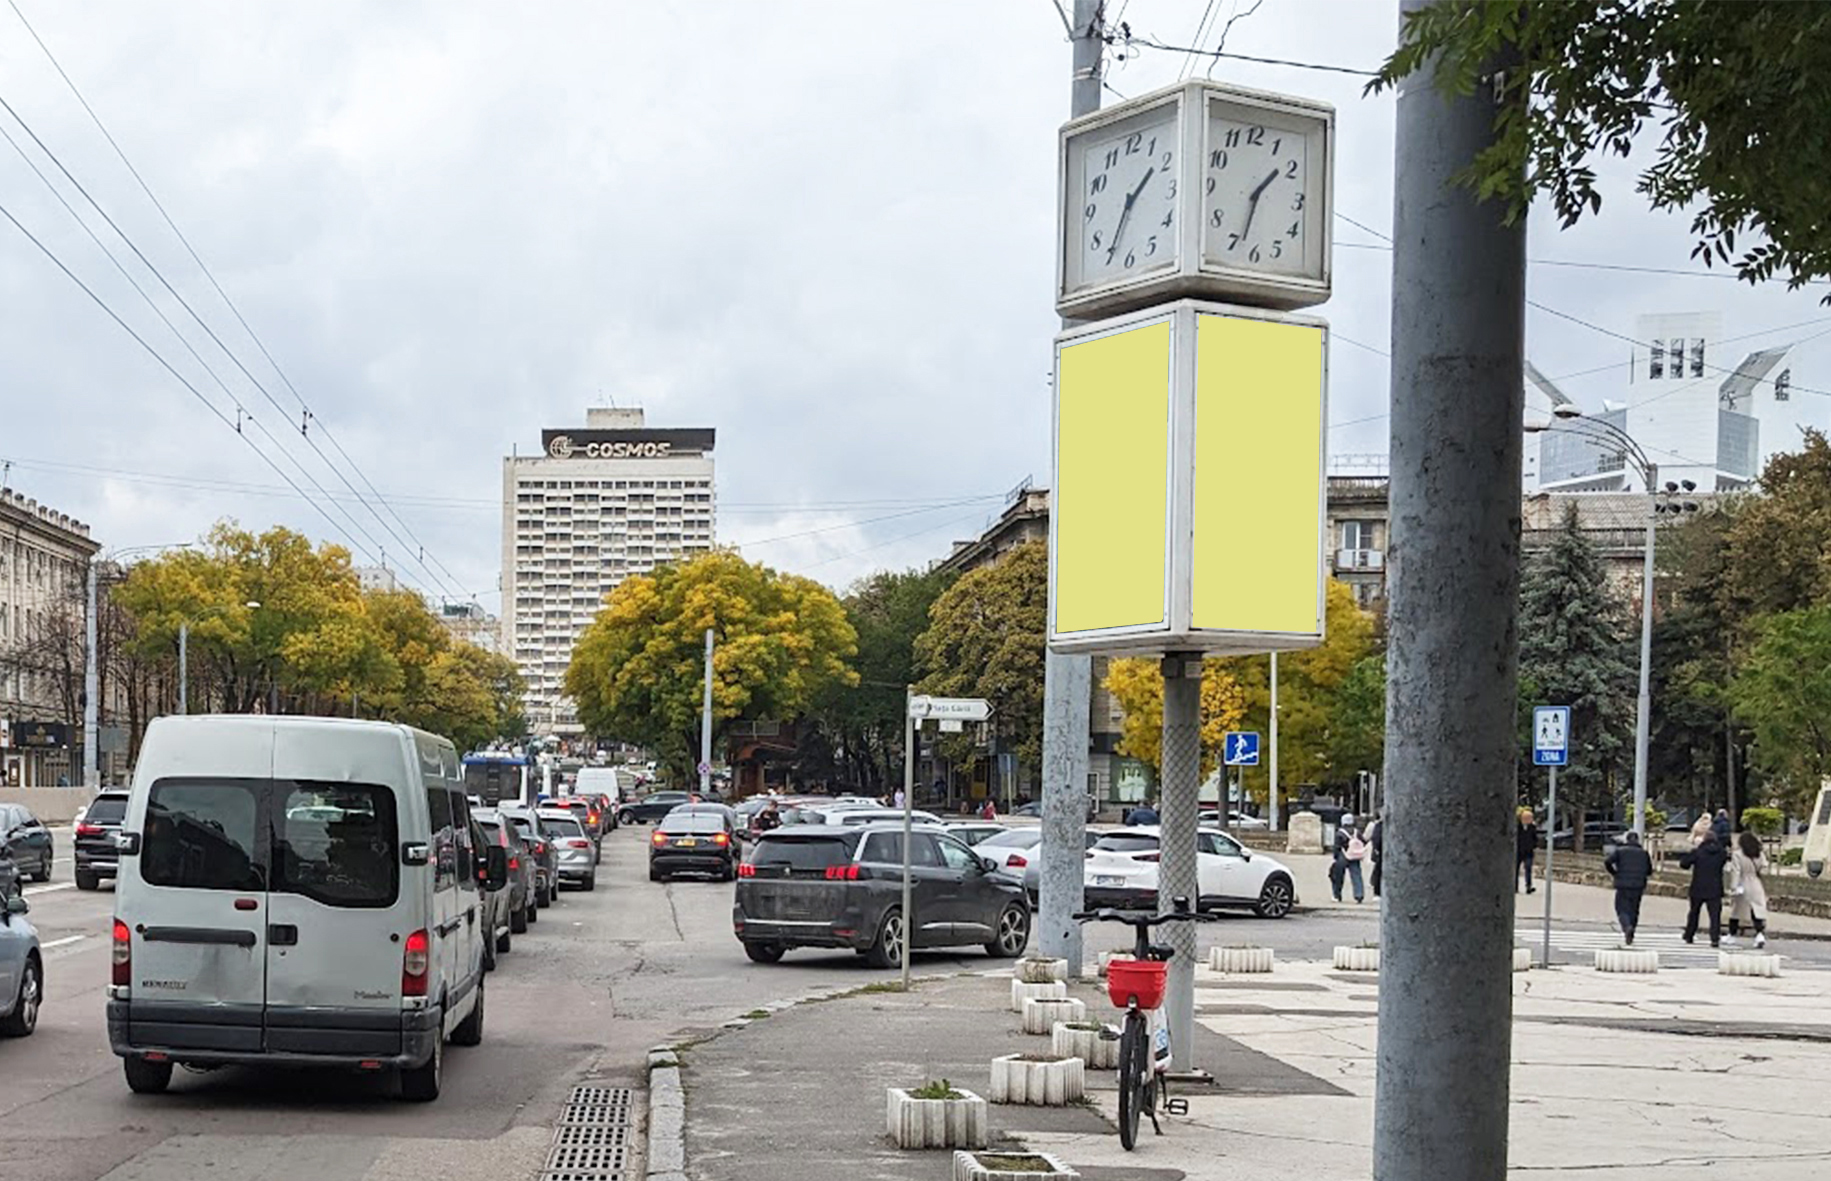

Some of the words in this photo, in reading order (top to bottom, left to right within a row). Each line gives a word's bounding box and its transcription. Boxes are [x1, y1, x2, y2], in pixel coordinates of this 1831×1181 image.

[1124, 132, 1142, 156] 12
[1225, 128, 1241, 148] 11
[1246, 125, 1265, 146] 12
[1148, 137, 1157, 157] 1
[1272, 138, 1282, 156] 1
[1105, 147, 1119, 170] 11
[1160, 152, 1172, 173] 2
[1209, 149, 1228, 170] 10
[1285, 159, 1298, 180] 2
[1090, 174, 1107, 196] 10
[1165, 179, 1177, 200] 3
[1206, 176, 1216, 197] 9
[1291, 192, 1305, 211] 3
[1085, 203, 1096, 224] 9
[1161, 209, 1174, 228] 4
[1210, 208, 1224, 229] 8
[1286, 220, 1299, 239] 4
[1091, 230, 1103, 251] 8
[1145, 236, 1157, 257] 5
[1227, 232, 1240, 251] 7
[1269, 240, 1282, 259] 5
[1124, 247, 1135, 269] 6
[1248, 243, 1260, 264] 6
[586, 442, 671, 458] COSMOS
[1541, 751, 1560, 761] ZONA
